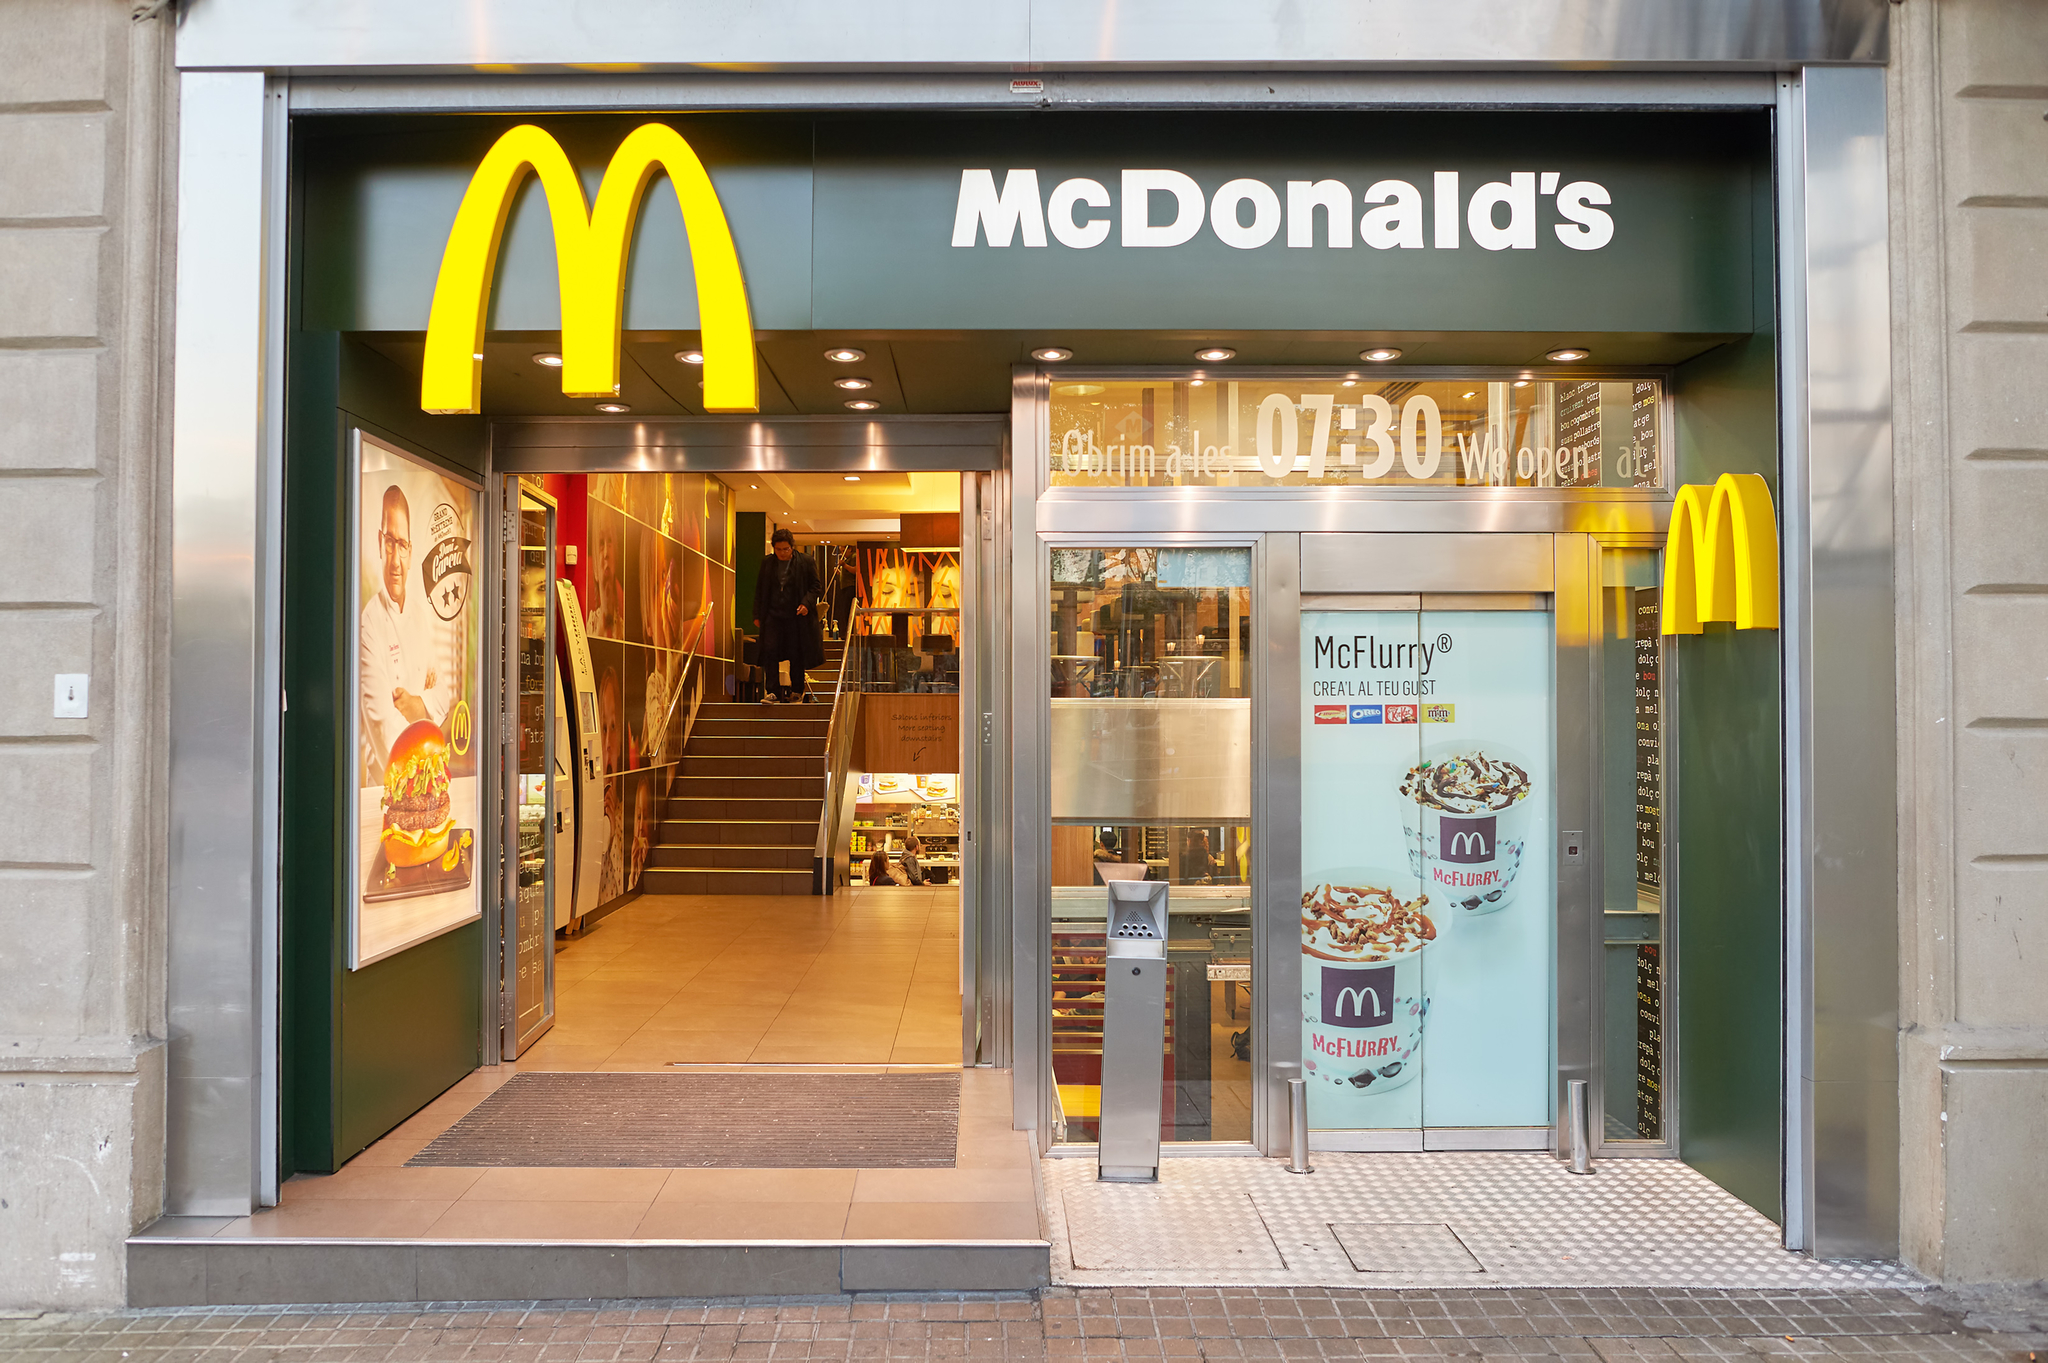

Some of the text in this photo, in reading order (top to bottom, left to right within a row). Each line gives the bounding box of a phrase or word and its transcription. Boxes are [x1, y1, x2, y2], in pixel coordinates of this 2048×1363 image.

[951, 168, 1615, 251] McDonald's
[1062, 393, 1646, 486] Obrim a les 07:30 We open at
[1313, 680, 1436, 696] CREA'L AL TEU GUST
[920, 712, 952, 722] inferiors
[1352, 709, 1381, 719] OREO
[918, 726, 946, 734] seating
